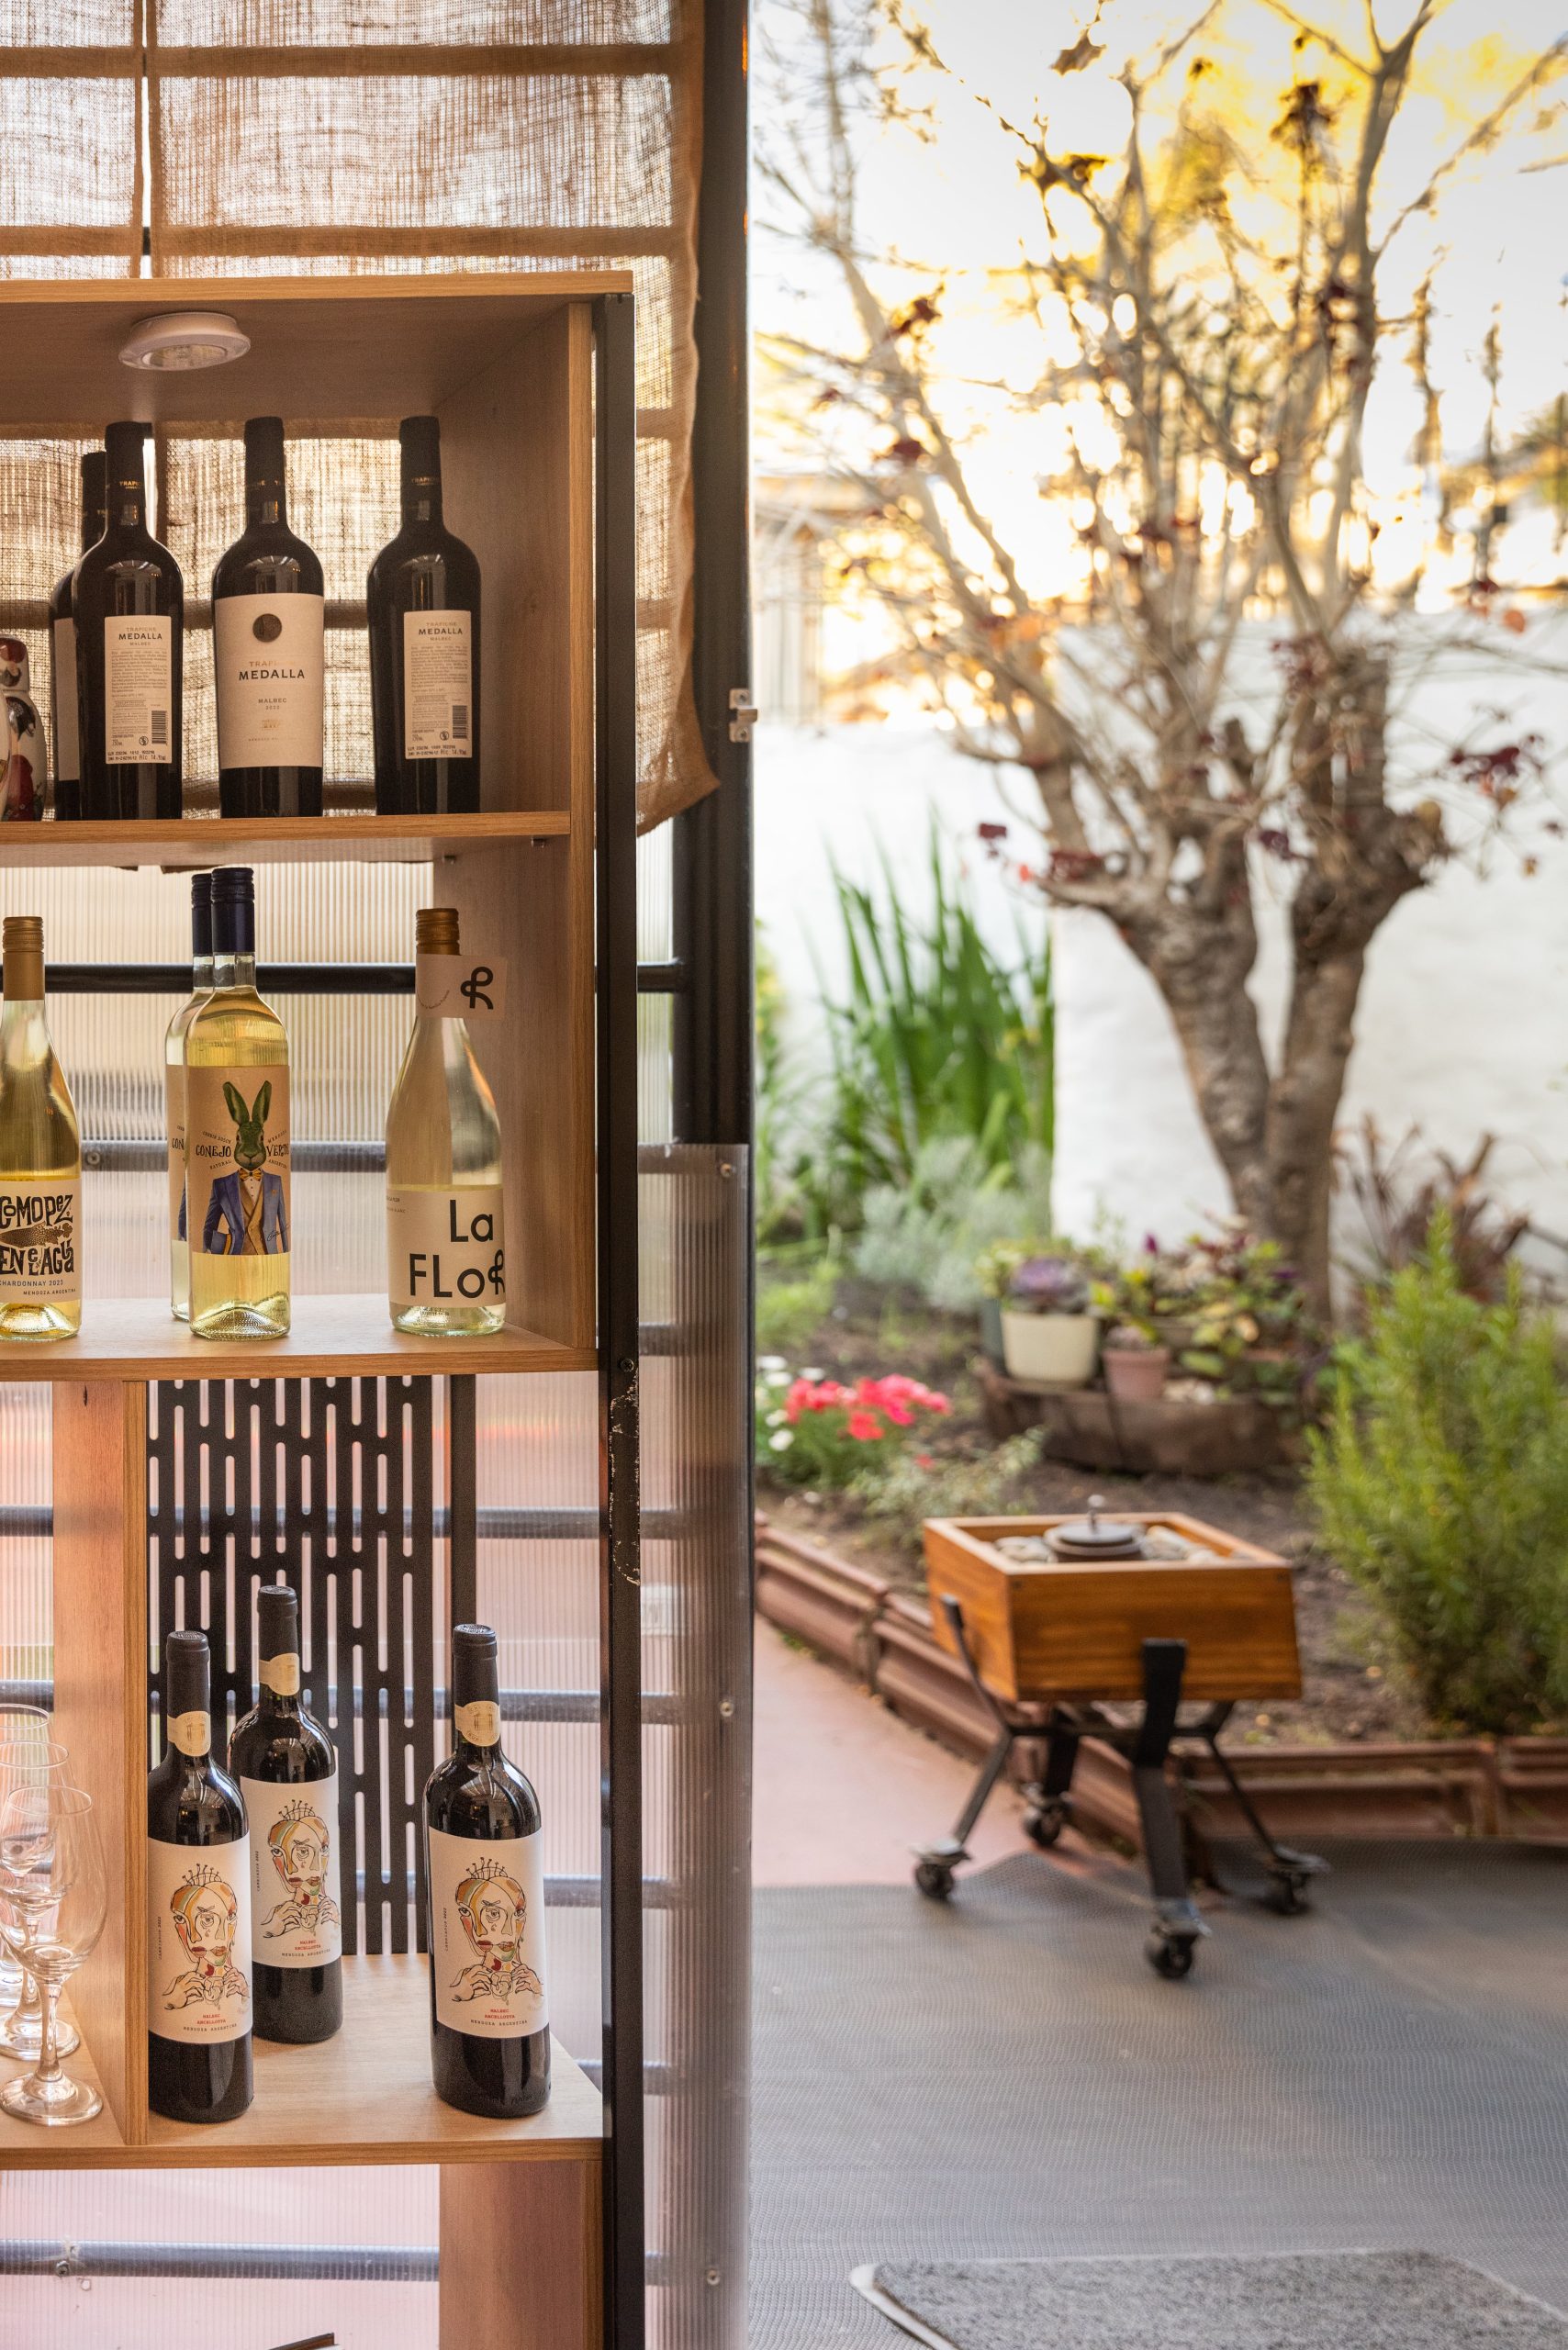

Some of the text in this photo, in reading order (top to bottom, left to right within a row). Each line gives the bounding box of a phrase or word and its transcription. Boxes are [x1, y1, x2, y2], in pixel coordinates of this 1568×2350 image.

[118, 632, 163, 641] MEDALLA
[418, 628, 464, 636] MEDALLA
[239, 669, 306, 681] MEDALLA
[196, 1144, 232, 1158] CONEJO
